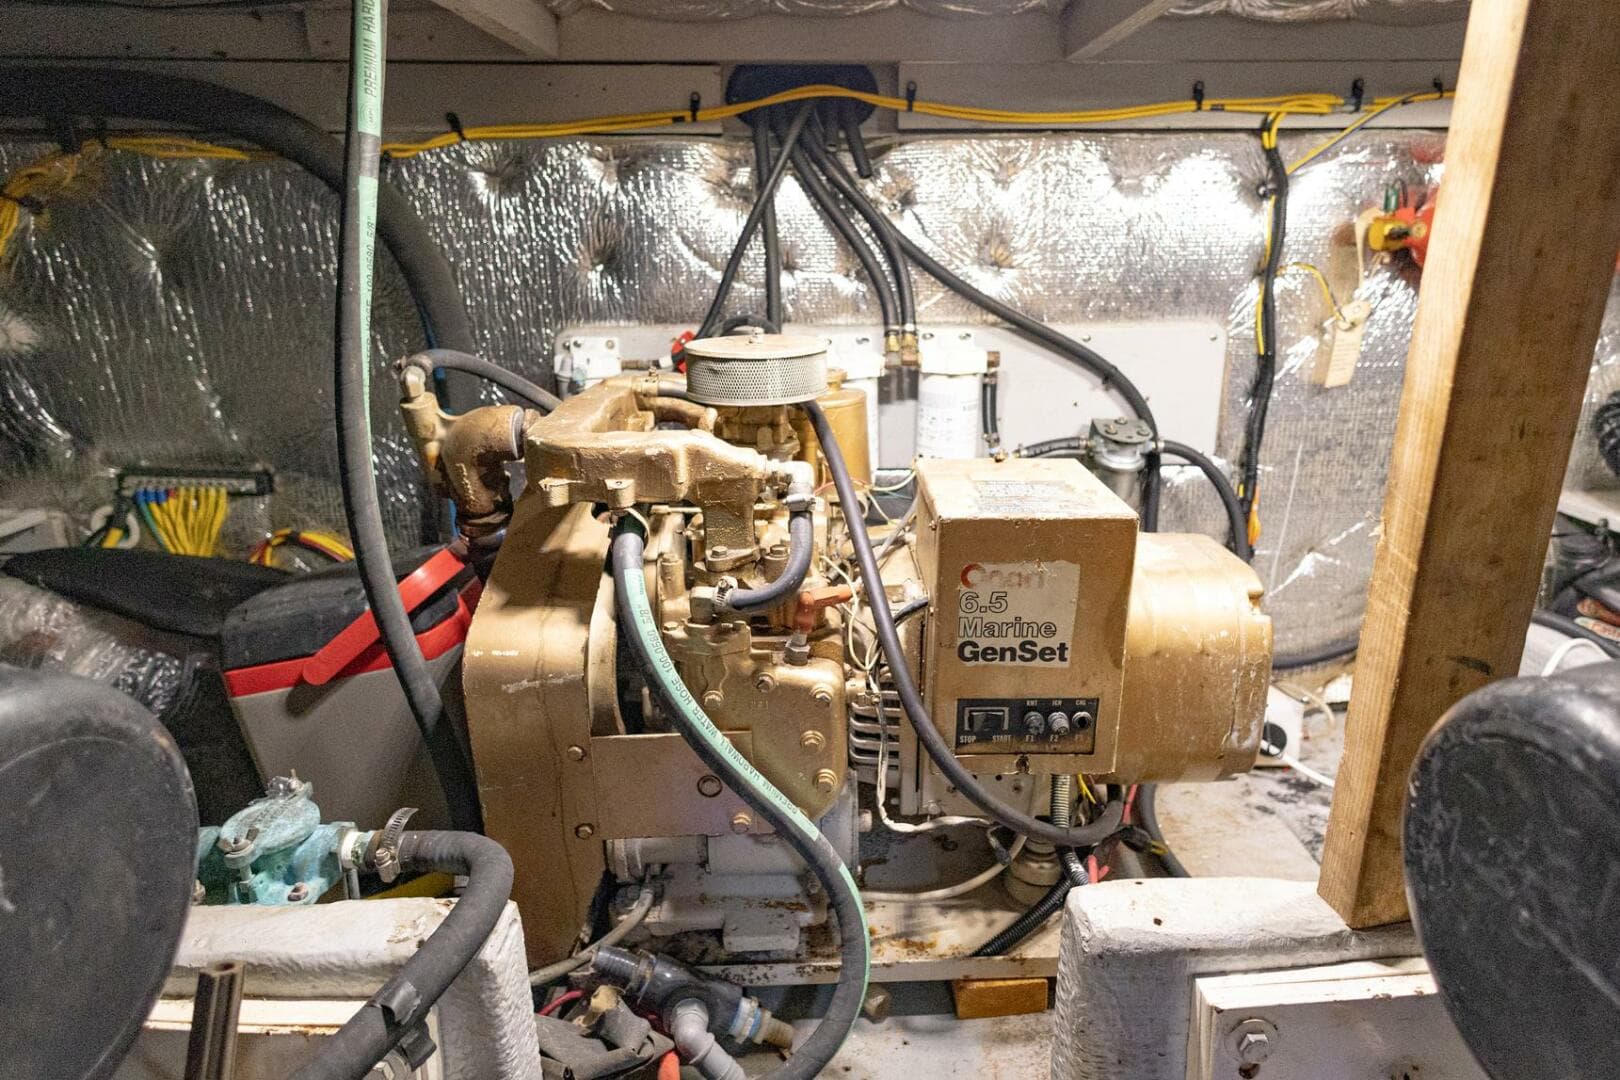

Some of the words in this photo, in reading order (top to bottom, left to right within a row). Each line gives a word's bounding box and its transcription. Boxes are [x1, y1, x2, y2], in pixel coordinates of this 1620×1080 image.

[363, 38, 377, 98] PREMIUM
[959, 591, 1009, 613] 6.5
[958, 616, 1058, 639] Marine
[646, 630, 674, 674] 100-0580
[957, 640, 1069, 662] GenSet
[671, 677, 692, 706] HOSE
[692, 705, 718, 738] WATER
[959, 735, 977, 743] STOP
[991, 735, 1012, 743] START
